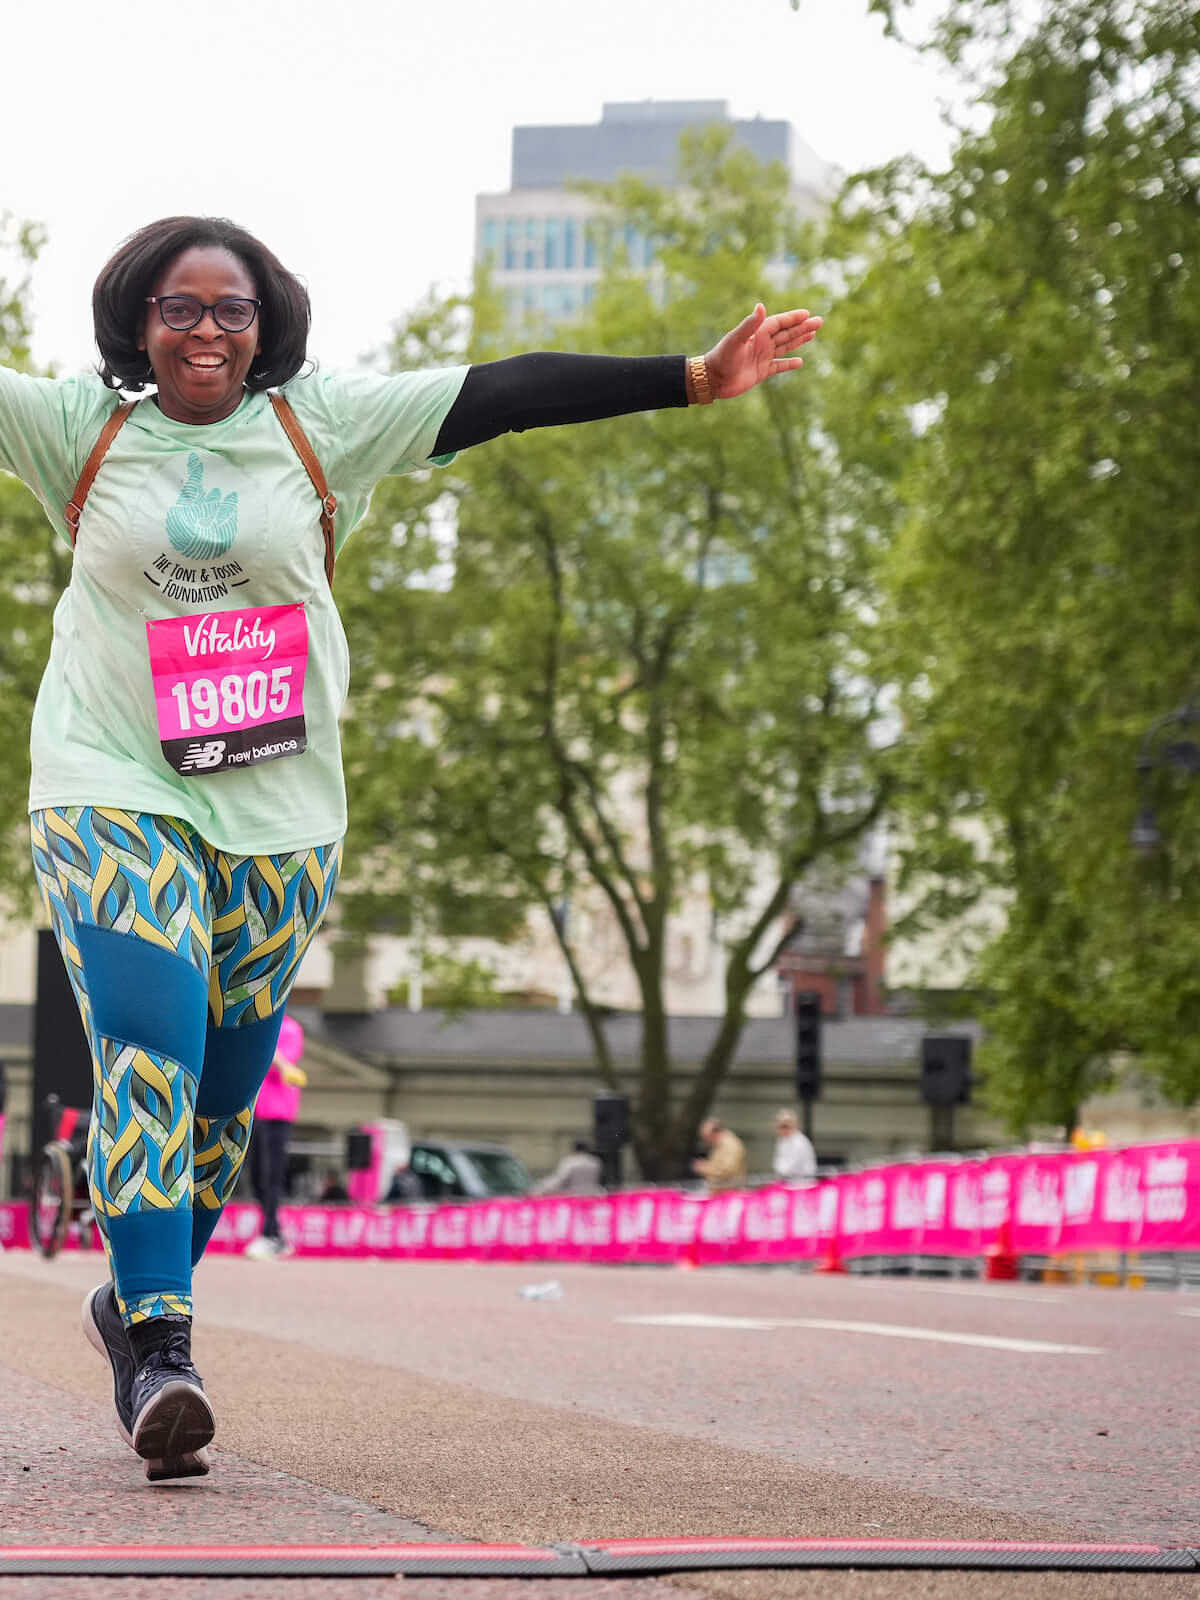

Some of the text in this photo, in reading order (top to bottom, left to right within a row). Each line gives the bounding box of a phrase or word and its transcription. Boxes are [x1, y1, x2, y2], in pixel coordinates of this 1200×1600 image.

[152, 552, 243, 583] THE TONI & TOSIN
[162, 579, 229, 604] FOUNDATION
[183, 614, 276, 661] Vitality
[171, 665, 293, 731] 19805
[179, 738, 298, 771] NB new balance
